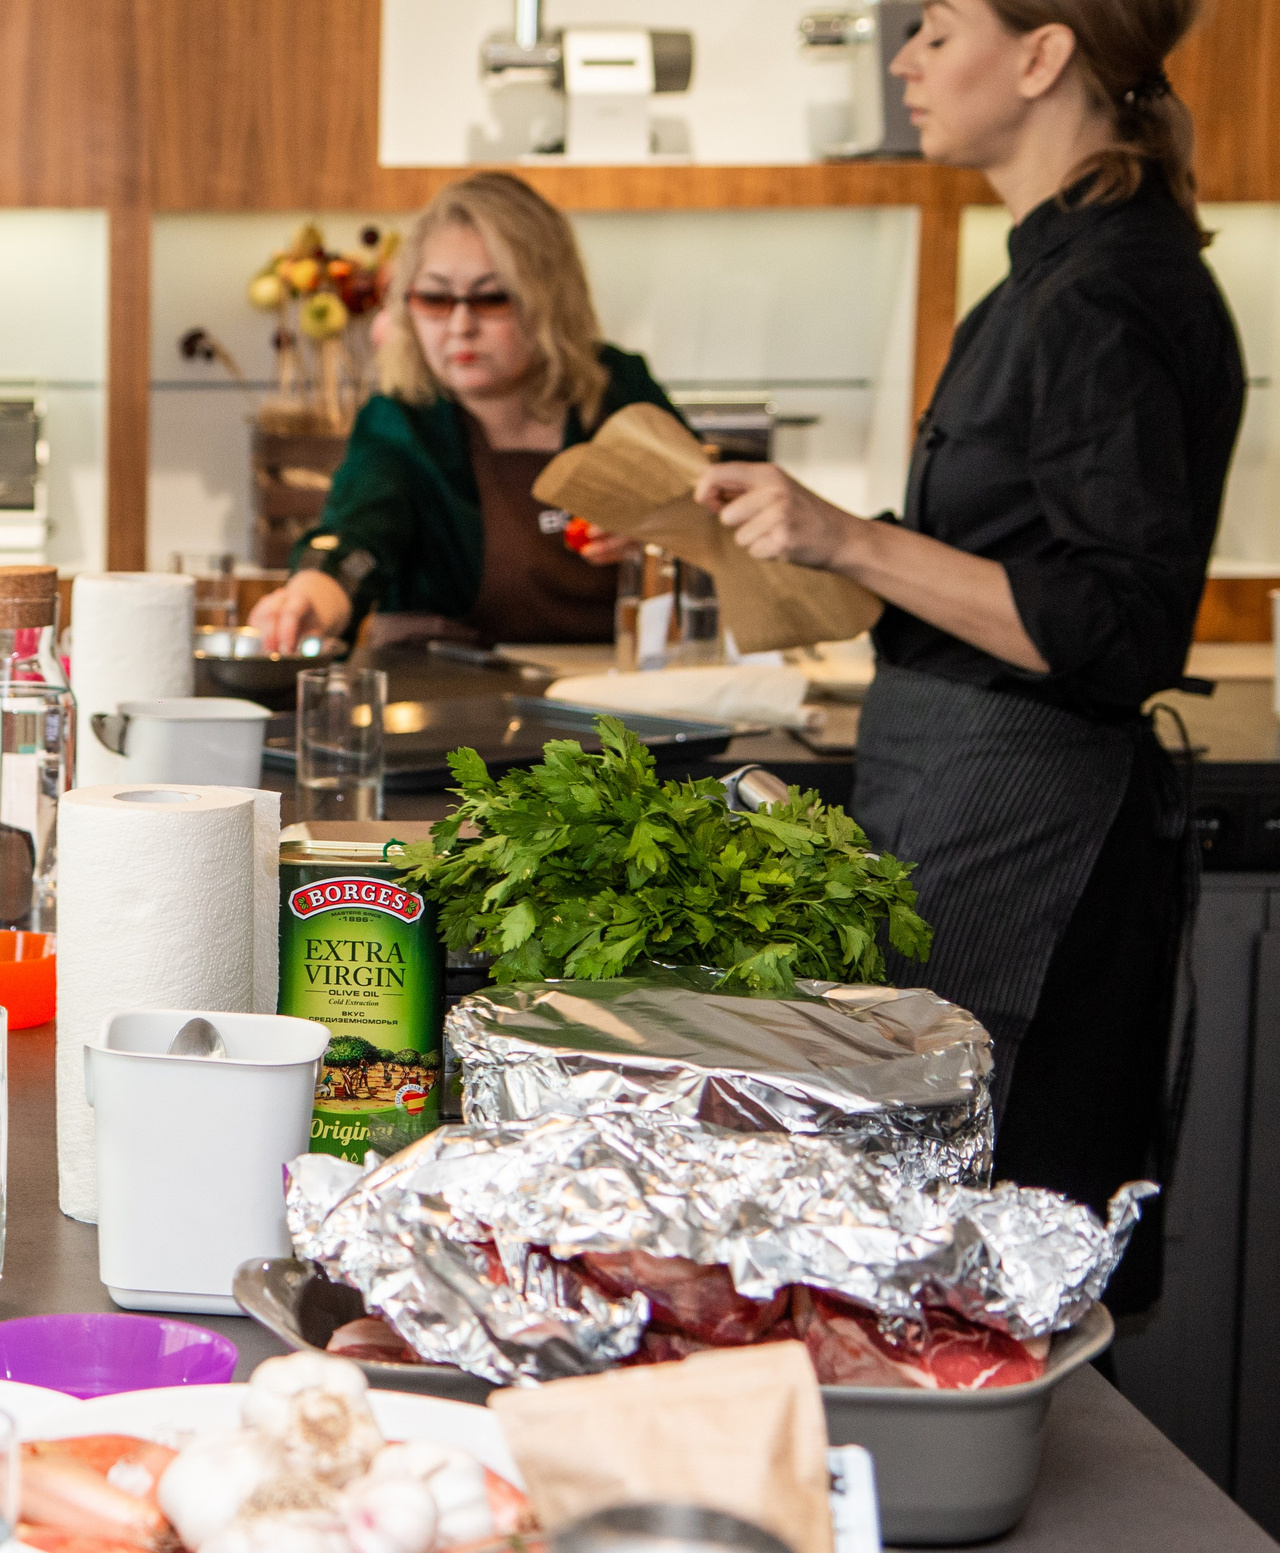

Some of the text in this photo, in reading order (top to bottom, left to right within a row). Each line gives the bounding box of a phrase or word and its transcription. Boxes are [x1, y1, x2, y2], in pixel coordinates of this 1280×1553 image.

[307, 883, 407, 910] BORGES
[304, 938, 406, 964] EXTRA
[304, 964, 406, 988] VIRGIN
[328, 989, 360, 997] OLIVE
[328, 998, 379, 1007] Cold Extraction
